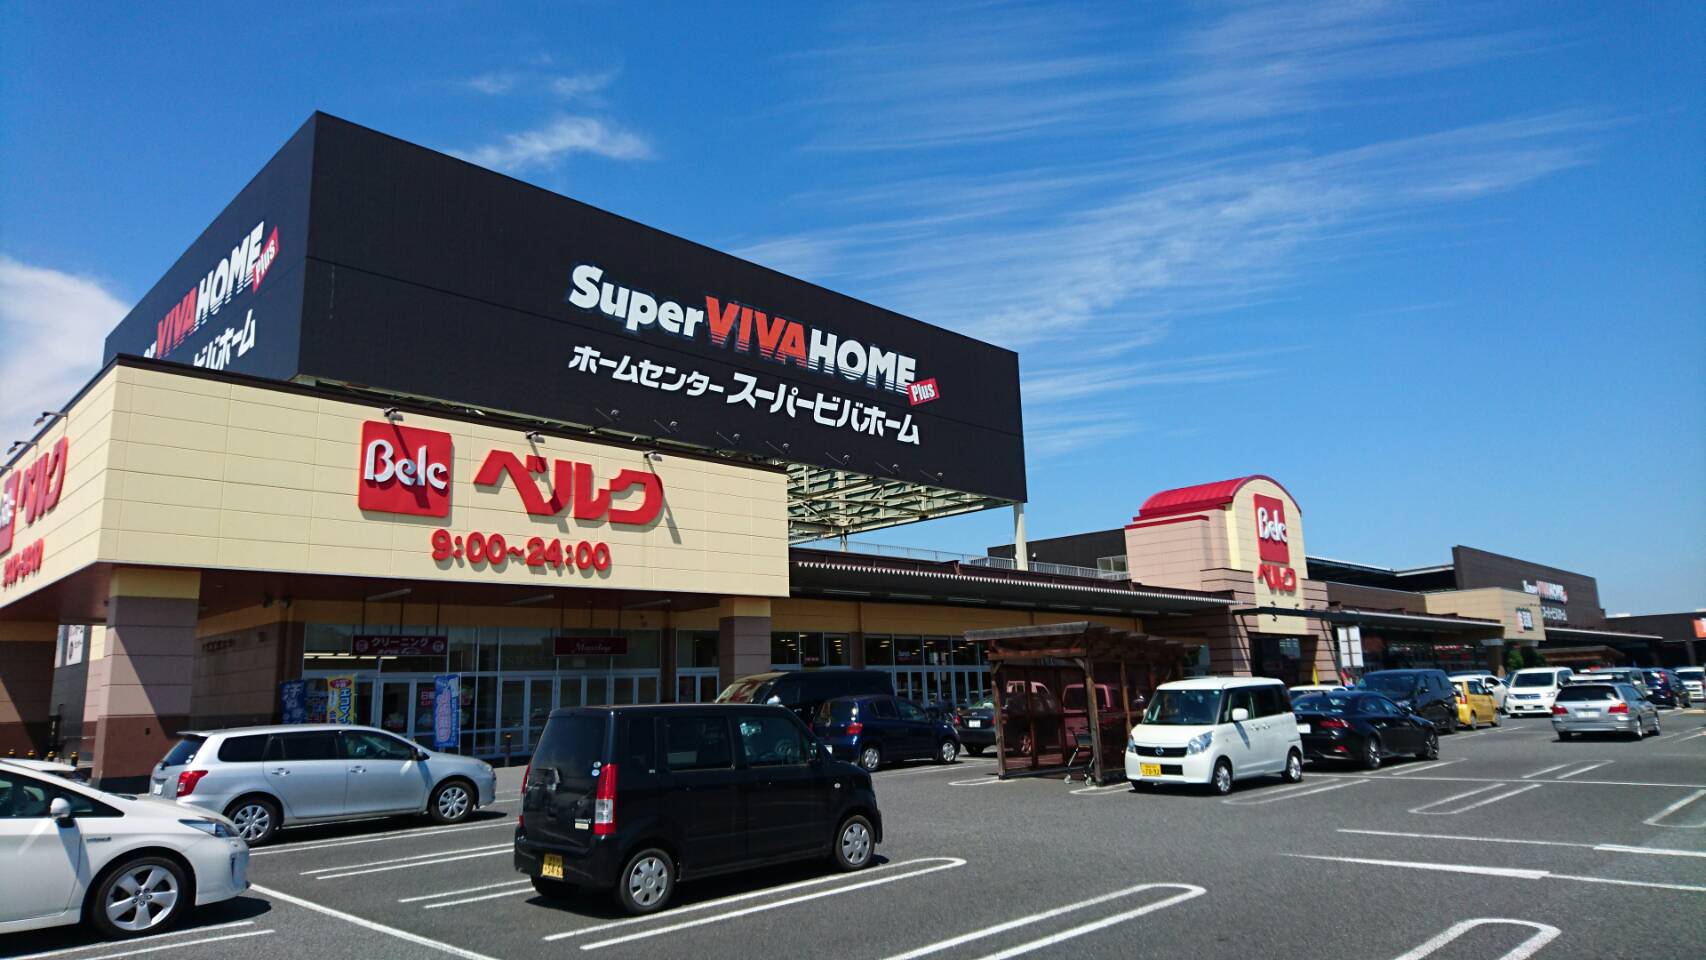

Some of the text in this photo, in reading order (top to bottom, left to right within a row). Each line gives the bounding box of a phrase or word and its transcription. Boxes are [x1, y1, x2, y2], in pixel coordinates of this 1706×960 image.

[256, 239, 276, 285] Plus
[911, 381, 936, 402] Plus
[363, 438, 448, 490] Belc
[473, 449, 663, 525] ベルク
[1257, 506, 1288, 543] Belc
[1257, 562, 1297, 593] ベルク
[370, 636, 430, 647] クリーニング
